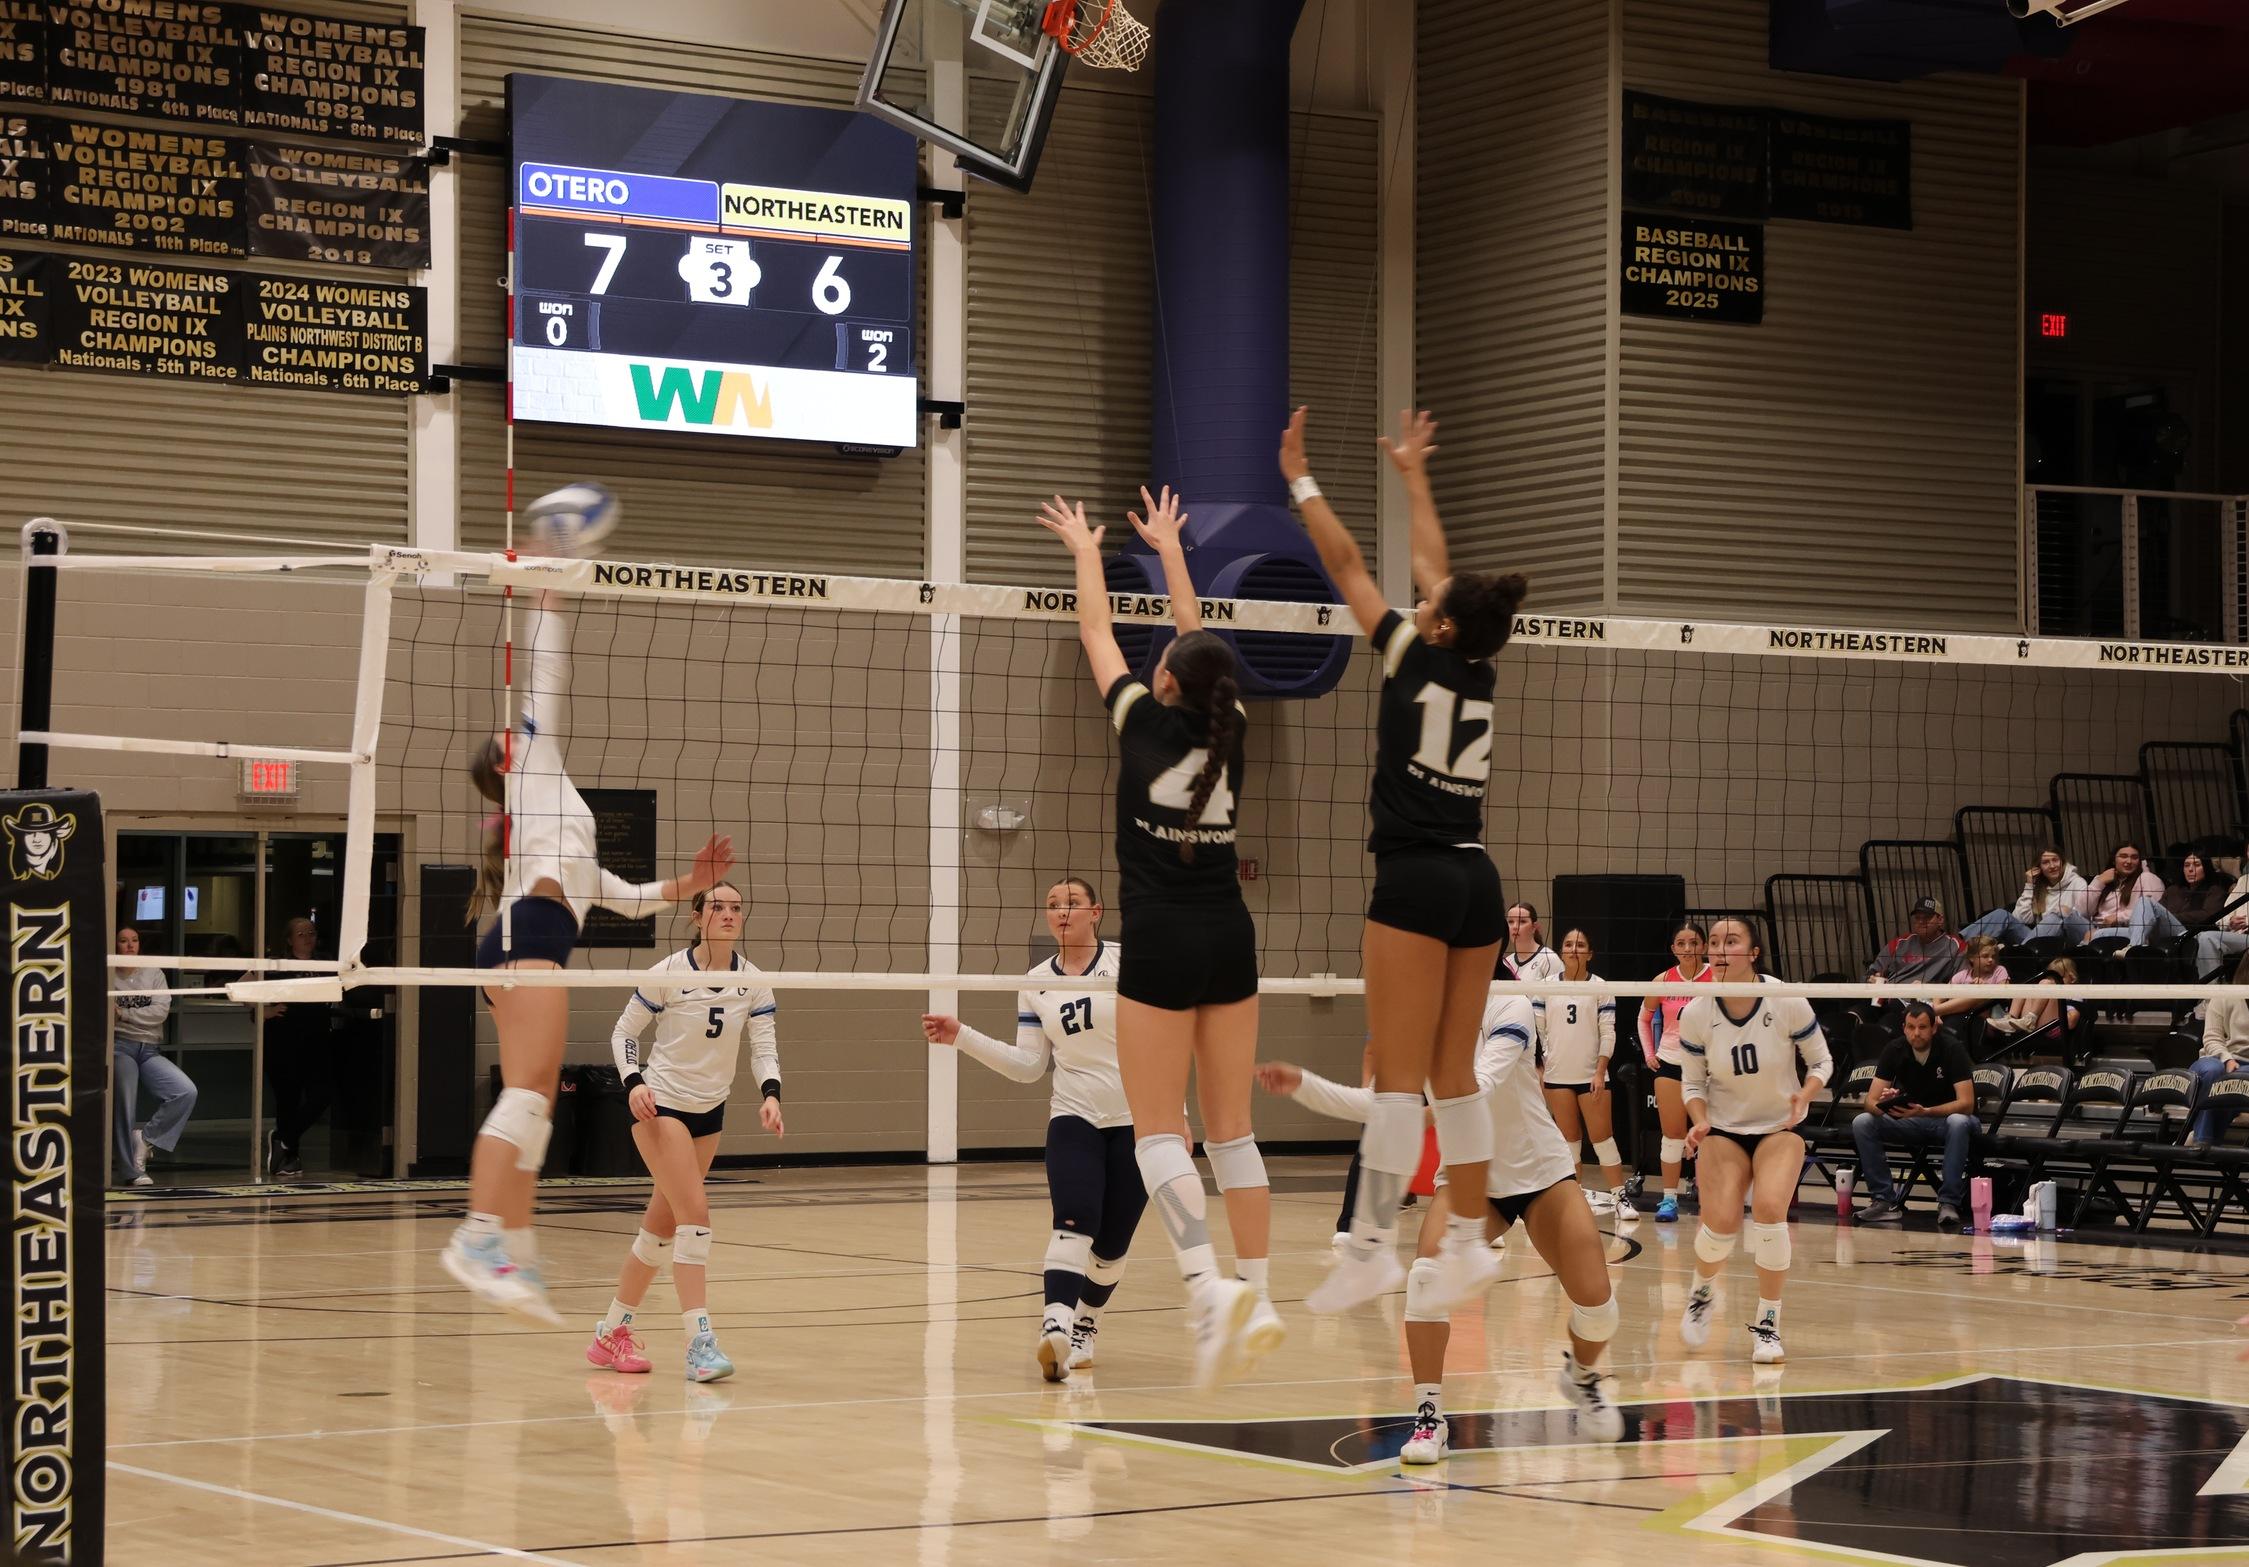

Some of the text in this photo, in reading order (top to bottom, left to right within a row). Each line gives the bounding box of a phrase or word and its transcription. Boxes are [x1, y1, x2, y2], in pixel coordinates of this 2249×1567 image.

[49, 6, 238, 46] VOLLEYBALL
[260, 13, 407, 47] WOMENS
[75, 30, 213, 64] REGION IX
[243, 30, 423, 69] VOLLEYBALL
[59, 48, 230, 86] CHAMPIONS
[268, 55, 399, 87] REGION IX
[115, 77, 176, 98] 1981
[255, 73, 416, 108] CHAMPIONS
[52, 87, 139, 110] NATIONALS
[161, 101, 189, 117] 4th
[197, 104, 238, 121] Place
[304, 100, 365, 121] 1982
[70, 124, 226, 158] WOMENS
[245, 110, 329, 132] NATIONALS
[350, 123, 377, 138] 8th
[384, 126, 423, 142] Place
[53, 142, 242, 179] VOLLEYBALL
[279, 148, 400, 174] WOMENS
[79, 167, 218, 197] REGION IX
[250, 163, 427, 194] VOLLEYBALL
[528, 171, 630, 205] OTERO
[64, 184, 234, 218] CHAMPIONS
[274, 197, 403, 223] REGION IX
[725, 195, 903, 229] NORTHEASTERN
[3, 219, 47, 235] Place
[114, 212, 185, 233] 2002
[258, 213, 420, 243] CHAMPIONS
[54, 224, 134, 246] NATIONALS
[154, 235, 183, 250] 11th
[190, 238, 229, 254] Place
[705, 243, 734, 255] SET
[1636, 226, 1750, 252] BASEBALL
[308, 246, 372, 264] 2018
[584, 232, 627, 295] 7
[1635, 246, 1749, 272] REGION IX
[68, 262, 229, 293] 2023 WOMENS
[709, 261, 733, 298] 3
[812, 256, 851, 315] 6
[1626, 266, 1758, 293] CHAMPIONS
[76, 285, 221, 315] VOLLEYBALL
[259, 281, 411, 309] 2024 WOMENS
[1666, 290, 1719, 309] 2025
[90, 309, 207, 336] REGION IX
[260, 302, 409, 330] VOLLEYBALL
[2042, 313, 2066, 337] EXIT
[80, 330, 217, 359] CHAMPIONS
[247, 323, 423, 353] PLAINS NORTHWEST DISTRICT B
[546, 316, 568, 347] 0
[59, 349, 141, 371] Nationals
[157, 357, 184, 375] 5th
[190, 360, 238, 379] Place
[262, 346, 415, 374] CHAMPIONS
[867, 343, 887, 372] 2
[251, 365, 329, 387] Nationals
[343, 372, 370, 389] 6th
[374, 375, 420, 392] Place
[396, 551, 422, 560] Senoh
[595, 563, 826, 598] NORTHEASTERN
[1025, 591, 1234, 620] NOREASRN
[1512, 617, 1605, 639] ASTERN
[1770, 630, 1946, 654] NORTHEASTERN
[2100, 644, 2249, 667] NORTHEASTER
[1410, 680, 1494, 780] 12
[253, 763, 289, 792] EXIT
[1148, 747, 1234, 825] 4
[706, 1007, 724, 1038] 5
[1060, 997, 1093, 1035] 27
[1566, 1004, 1577, 1024] 3
[1731, 1043, 1759, 1076] 10
[10, 901, 72, 1566] NORTHEASTERN
